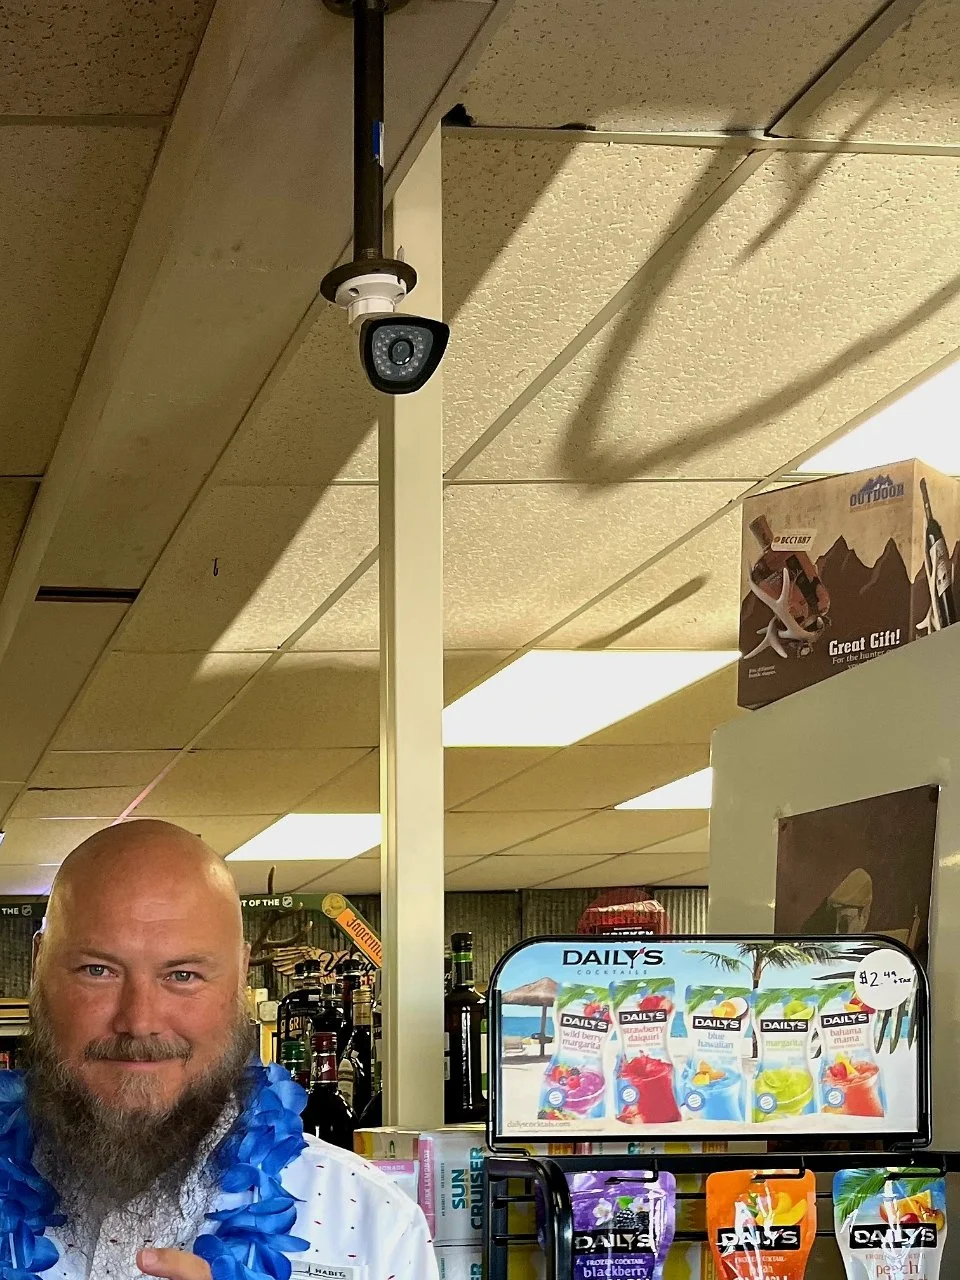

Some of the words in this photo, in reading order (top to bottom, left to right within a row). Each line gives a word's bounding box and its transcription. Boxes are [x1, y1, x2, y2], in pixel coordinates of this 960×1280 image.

[849, 482, 904, 507] OUTDOOR
[829, 637, 866, 657] Great
[870, 629, 901, 649] Gift!
[832, 655, 845, 665] For
[846, 652, 859, 663] the
[248, 899, 261, 907] OF
[263, 898, 280, 906] THE
[1, 907, 19, 915] THE
[562, 946, 664, 969] DAILY'S
[621, 1010, 666, 1022] DAILY'S
[823, 1013, 867, 1026] DAILY'S
[562, 1016, 608, 1030] DAILY'S
[694, 1018, 739, 1029] DAILY'S
[762, 1021, 807, 1030] DAILY'S
[451, 1168, 465, 1210] SUN
[469, 1147, 483, 1230] CRUISER
[583, 1266, 650, 1278] blackberry
